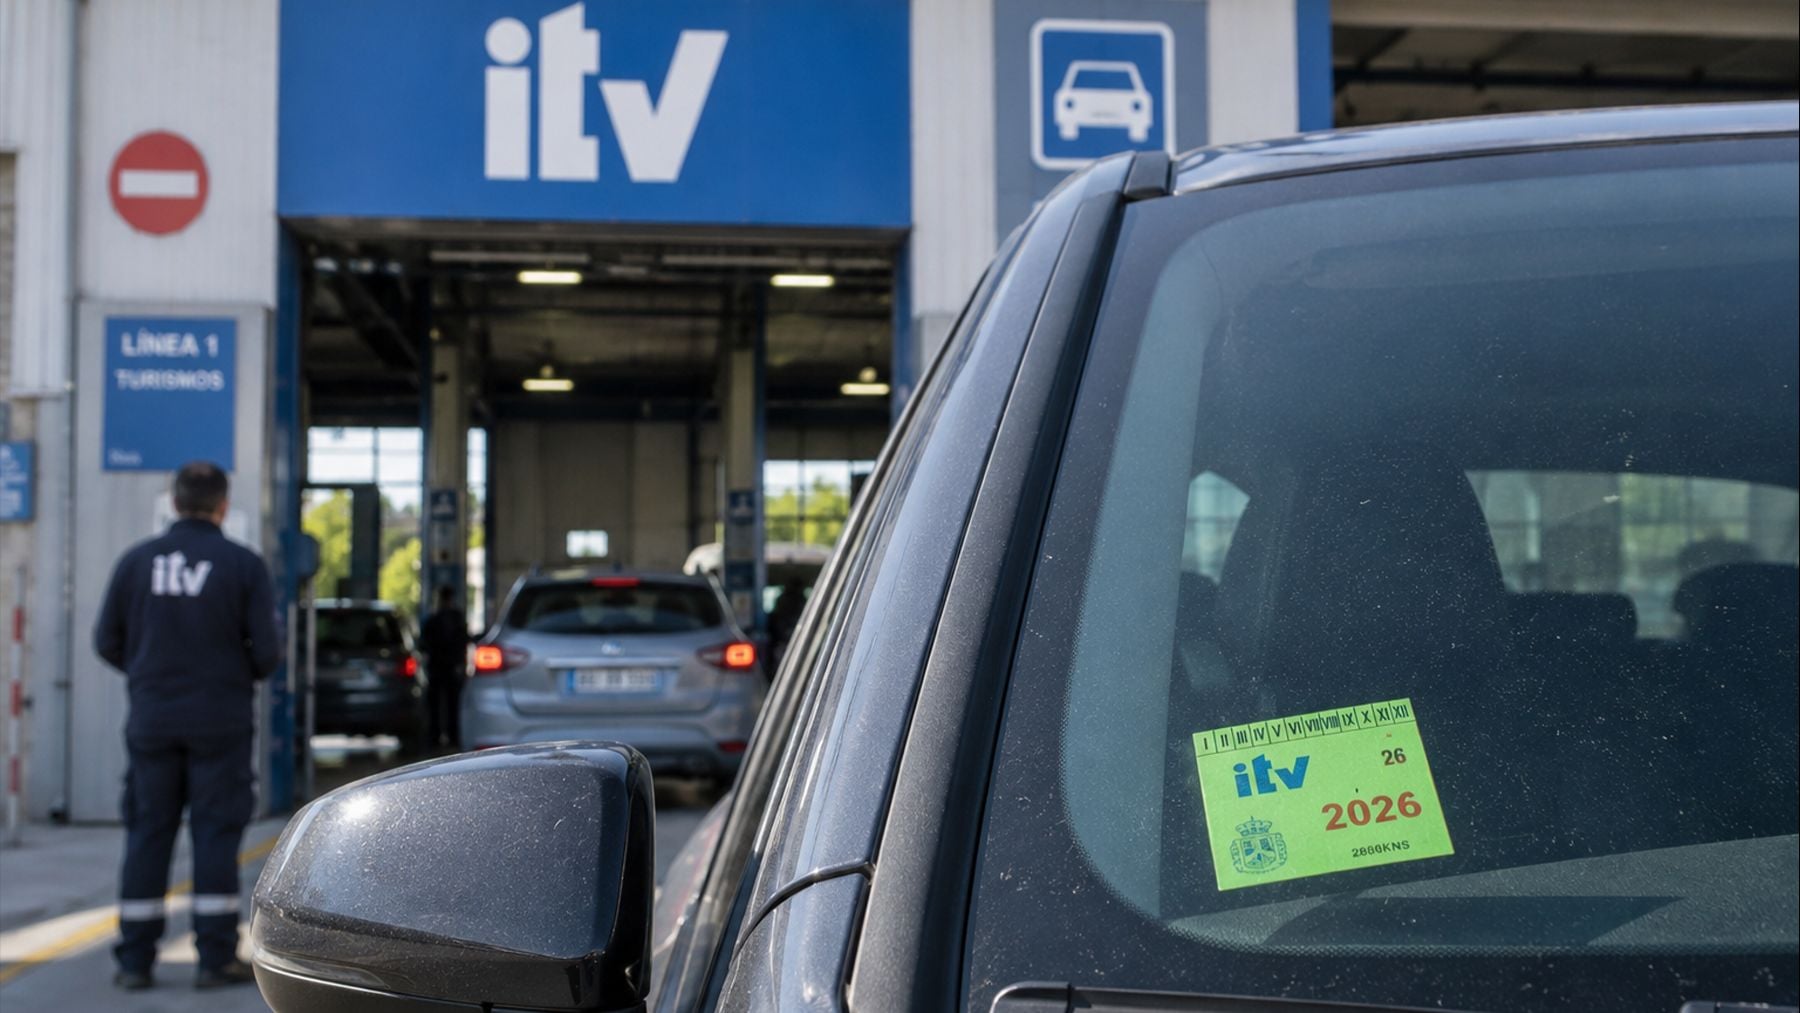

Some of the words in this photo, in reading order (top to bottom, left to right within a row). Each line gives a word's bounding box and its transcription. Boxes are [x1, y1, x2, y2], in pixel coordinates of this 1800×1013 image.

[484, 1, 729, 182] itv
[205, 333, 218, 357] 1
[115, 370, 224, 390] TURISMOS
[152, 551, 212, 596] itv
[1220, 734, 1229, 747] II
[1253, 728, 1264, 741] IV
[1272, 724, 1281, 737] V
[1288, 722, 1302, 735] VI
[1342, 713, 1355, 726] IX
[1361, 711, 1371, 723] X
[1377, 708, 1390, 722] XI
[1393, 705, 1409, 719] XII
[1233, 754, 1310, 798] itv
[1381, 748, 1406, 766] 26
[1321, 791, 1422, 831] 2026
